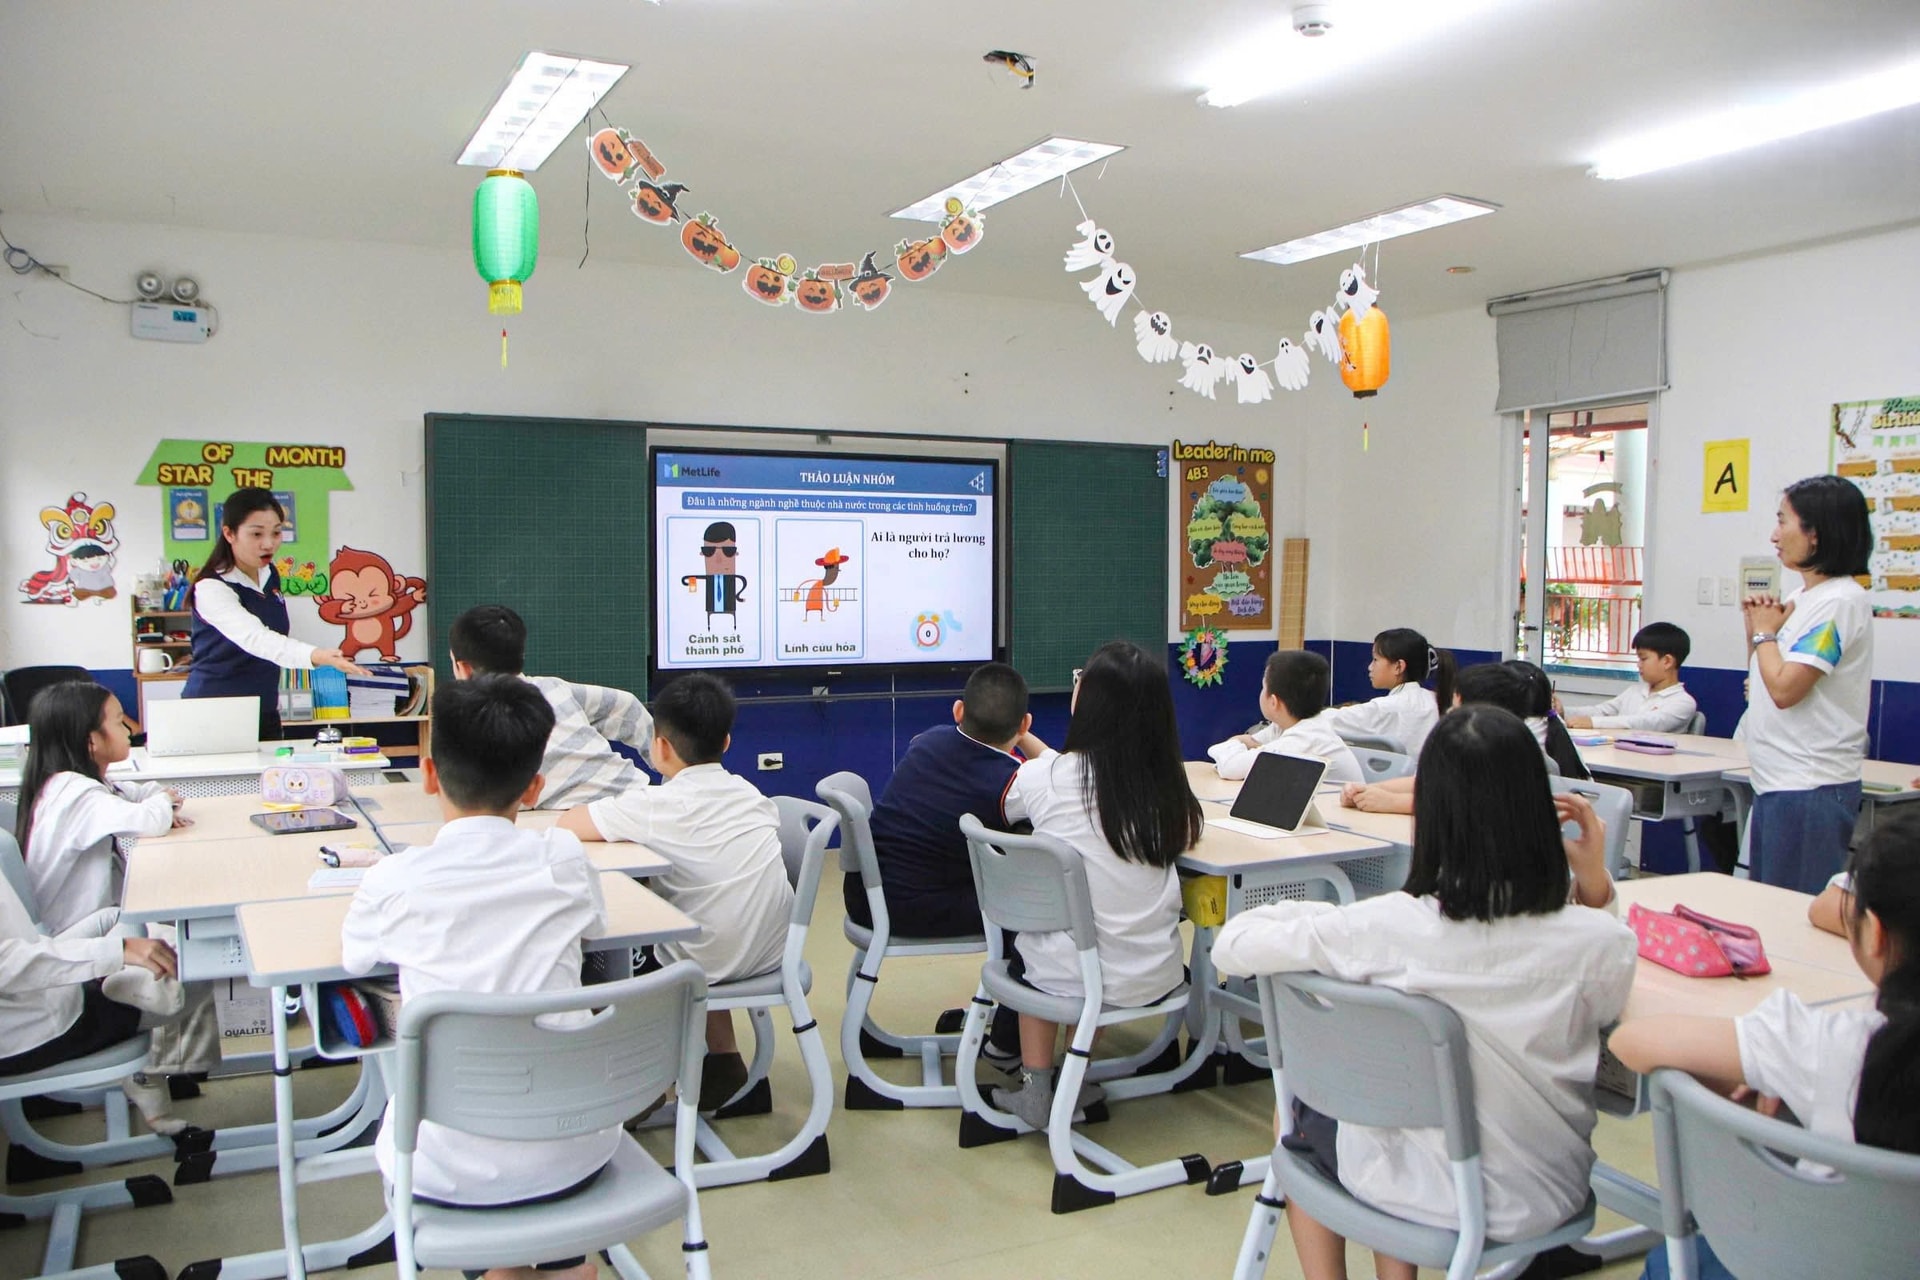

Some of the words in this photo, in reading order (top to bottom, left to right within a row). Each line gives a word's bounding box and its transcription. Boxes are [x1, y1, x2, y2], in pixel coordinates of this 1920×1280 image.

[1174, 440, 1231, 460] Leader
[1232, 444, 1247, 462] in
[1250, 449, 1274, 463] me
[158, 464, 213, 485] STAR
[203, 444, 233, 462] OF
[232, 468, 272, 488] THE
[268, 447, 344, 467] MONTH
[681, 466, 720, 477] MetLife
[1186, 466, 1208, 481] 4B3
[800, 471, 830, 484] THẢO
[833, 472, 861, 486] LUẬN
[863, 472, 895, 486] NHÓM
[1714, 462, 1738, 495] A
[708, 497, 715, 506] là
[718, 497, 747, 509] những
[749, 498, 775, 509] ngành
[778, 497, 799, 511] nghề
[801, 499, 825, 510] thuộc
[827, 500, 843, 510] nhà
[845, 500, 866, 511] nước
[868, 502, 890, 512] trong
[892, 501, 905, 511] các
[952, 502, 973, 512] trên?
[871, 532, 883, 542] Ai
[886, 532, 896, 542] là
[898, 532, 932, 545] người
[935, 532, 950, 543] trả
[953, 533, 986, 546] lương
[908, 548, 928, 559] cho
[931, 548, 950, 561] họ?
[224, 1027, 266, 1037] QUALITY
